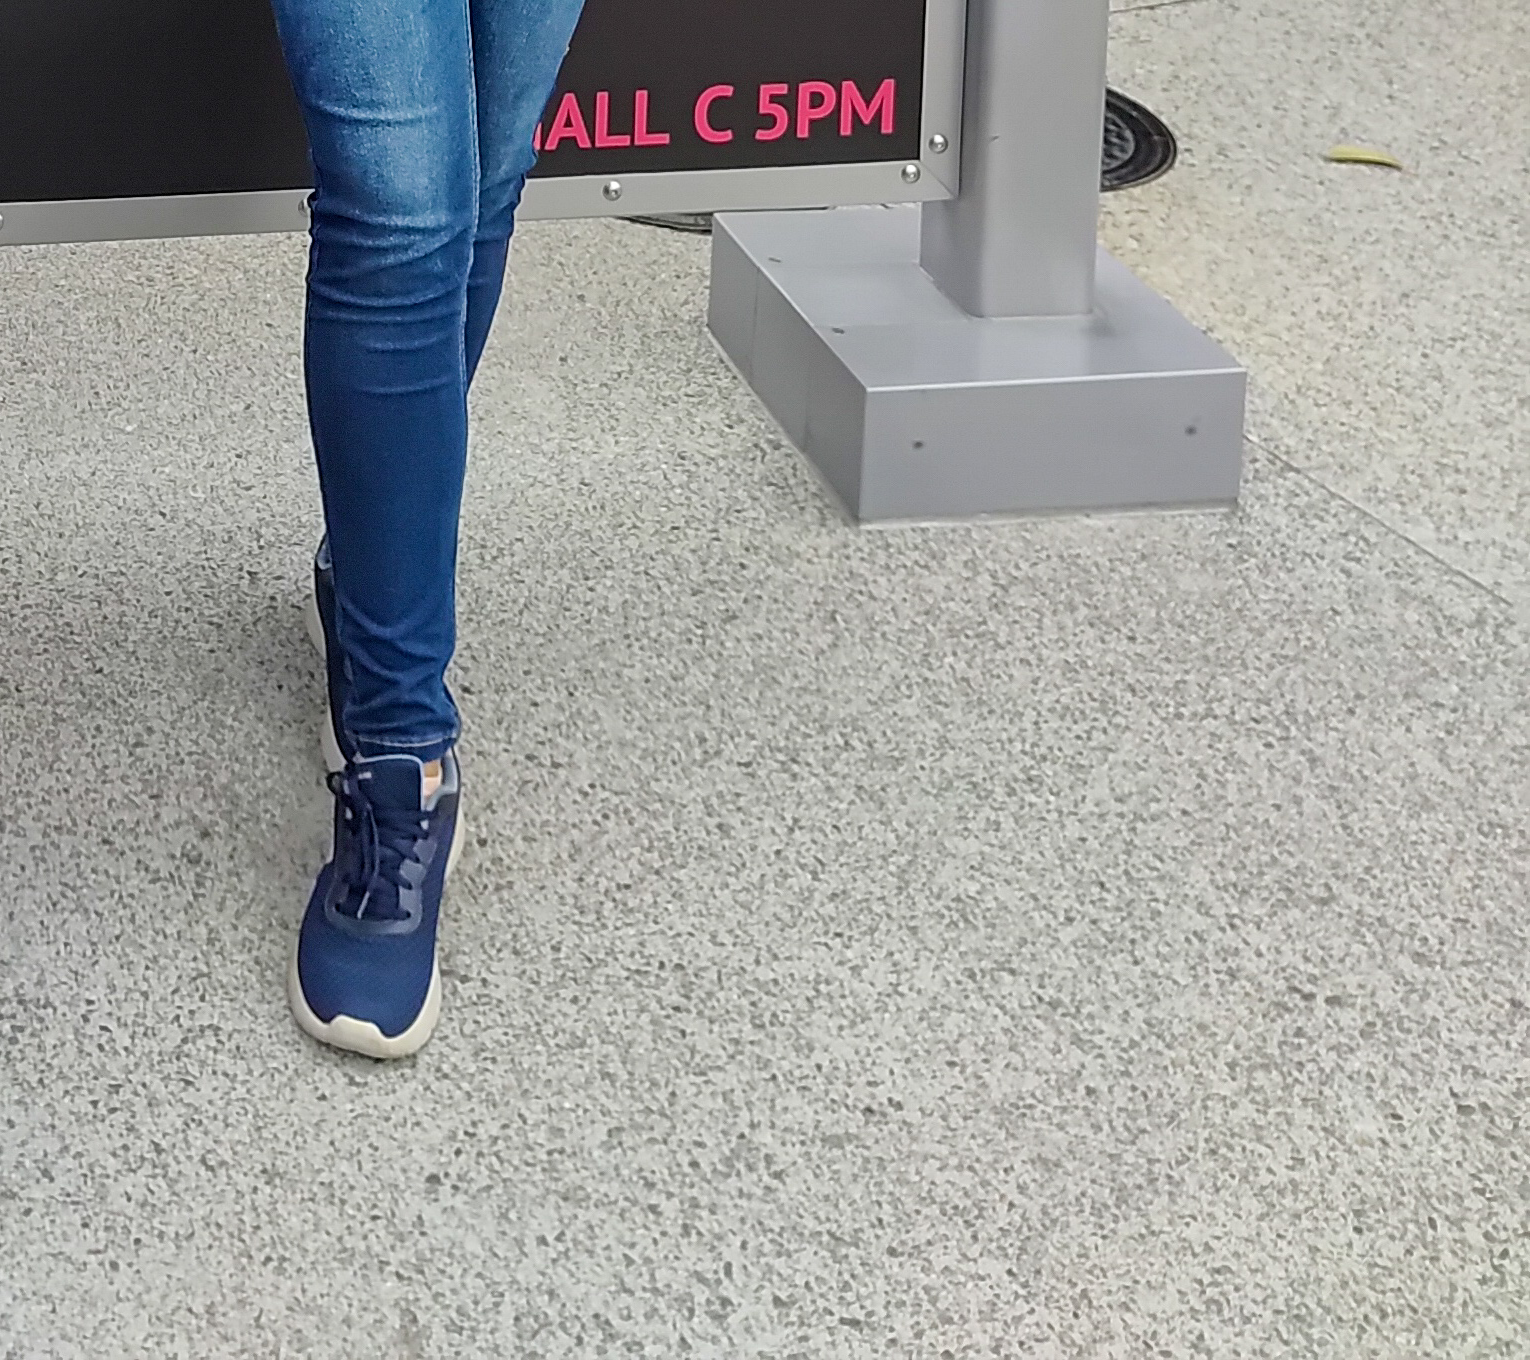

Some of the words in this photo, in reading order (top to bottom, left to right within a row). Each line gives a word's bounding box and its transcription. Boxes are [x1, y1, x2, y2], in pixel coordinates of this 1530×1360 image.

[534, 89, 670, 151] ALL
[694, 85, 735, 143] C
[755, 79, 896, 141] 5PM
